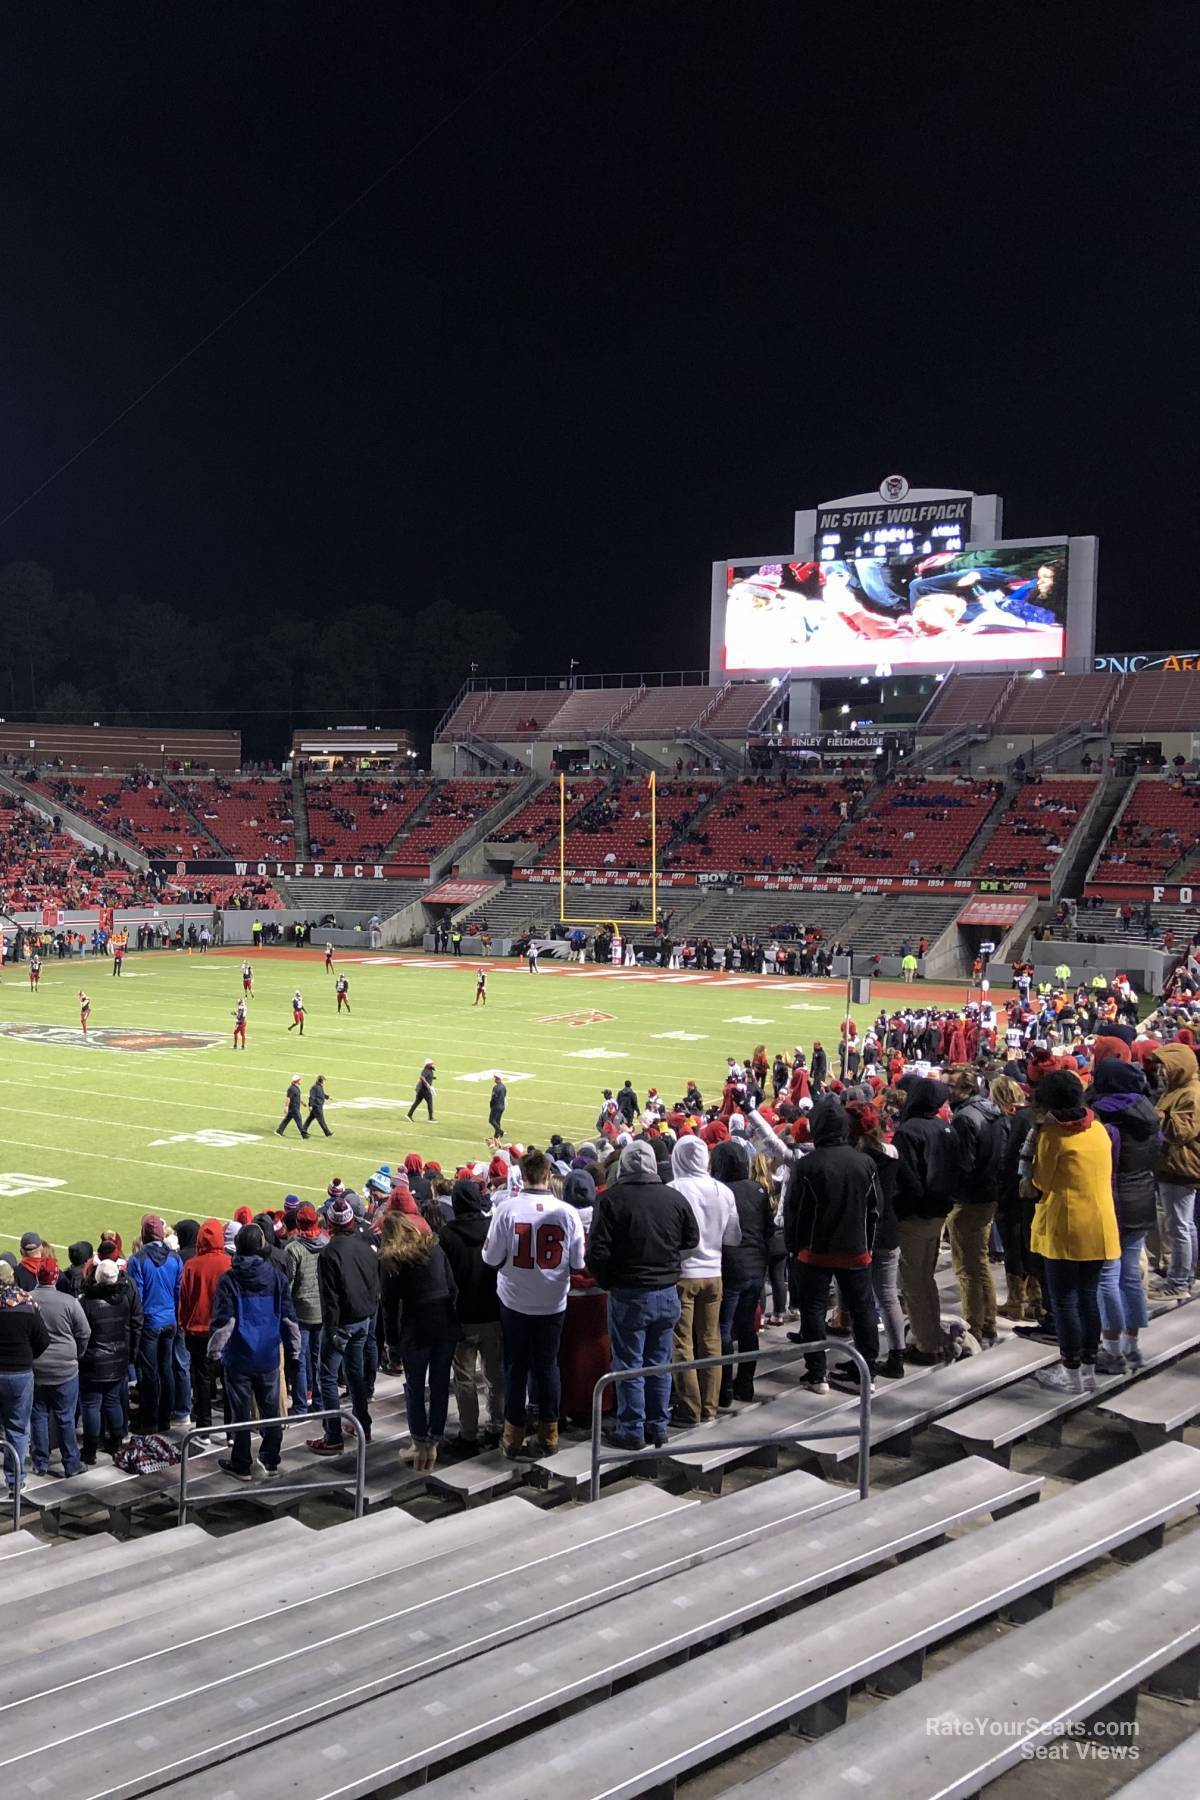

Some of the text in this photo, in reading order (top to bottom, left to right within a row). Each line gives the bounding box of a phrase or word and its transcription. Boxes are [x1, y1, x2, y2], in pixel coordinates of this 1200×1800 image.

[820, 503, 967, 529] NC STATE WOLFPACK
[1094, 656, 1148, 672] PNC
[791, 738, 822, 747] FINLEY
[827, 737, 884, 747] FIELDHOUSE
[234, 862, 384, 878] WOLFPACK
[333, 951, 851, 987] NC STATE
[169, 1128, 264, 1148] 30
[512, 1222, 566, 1270] 16
